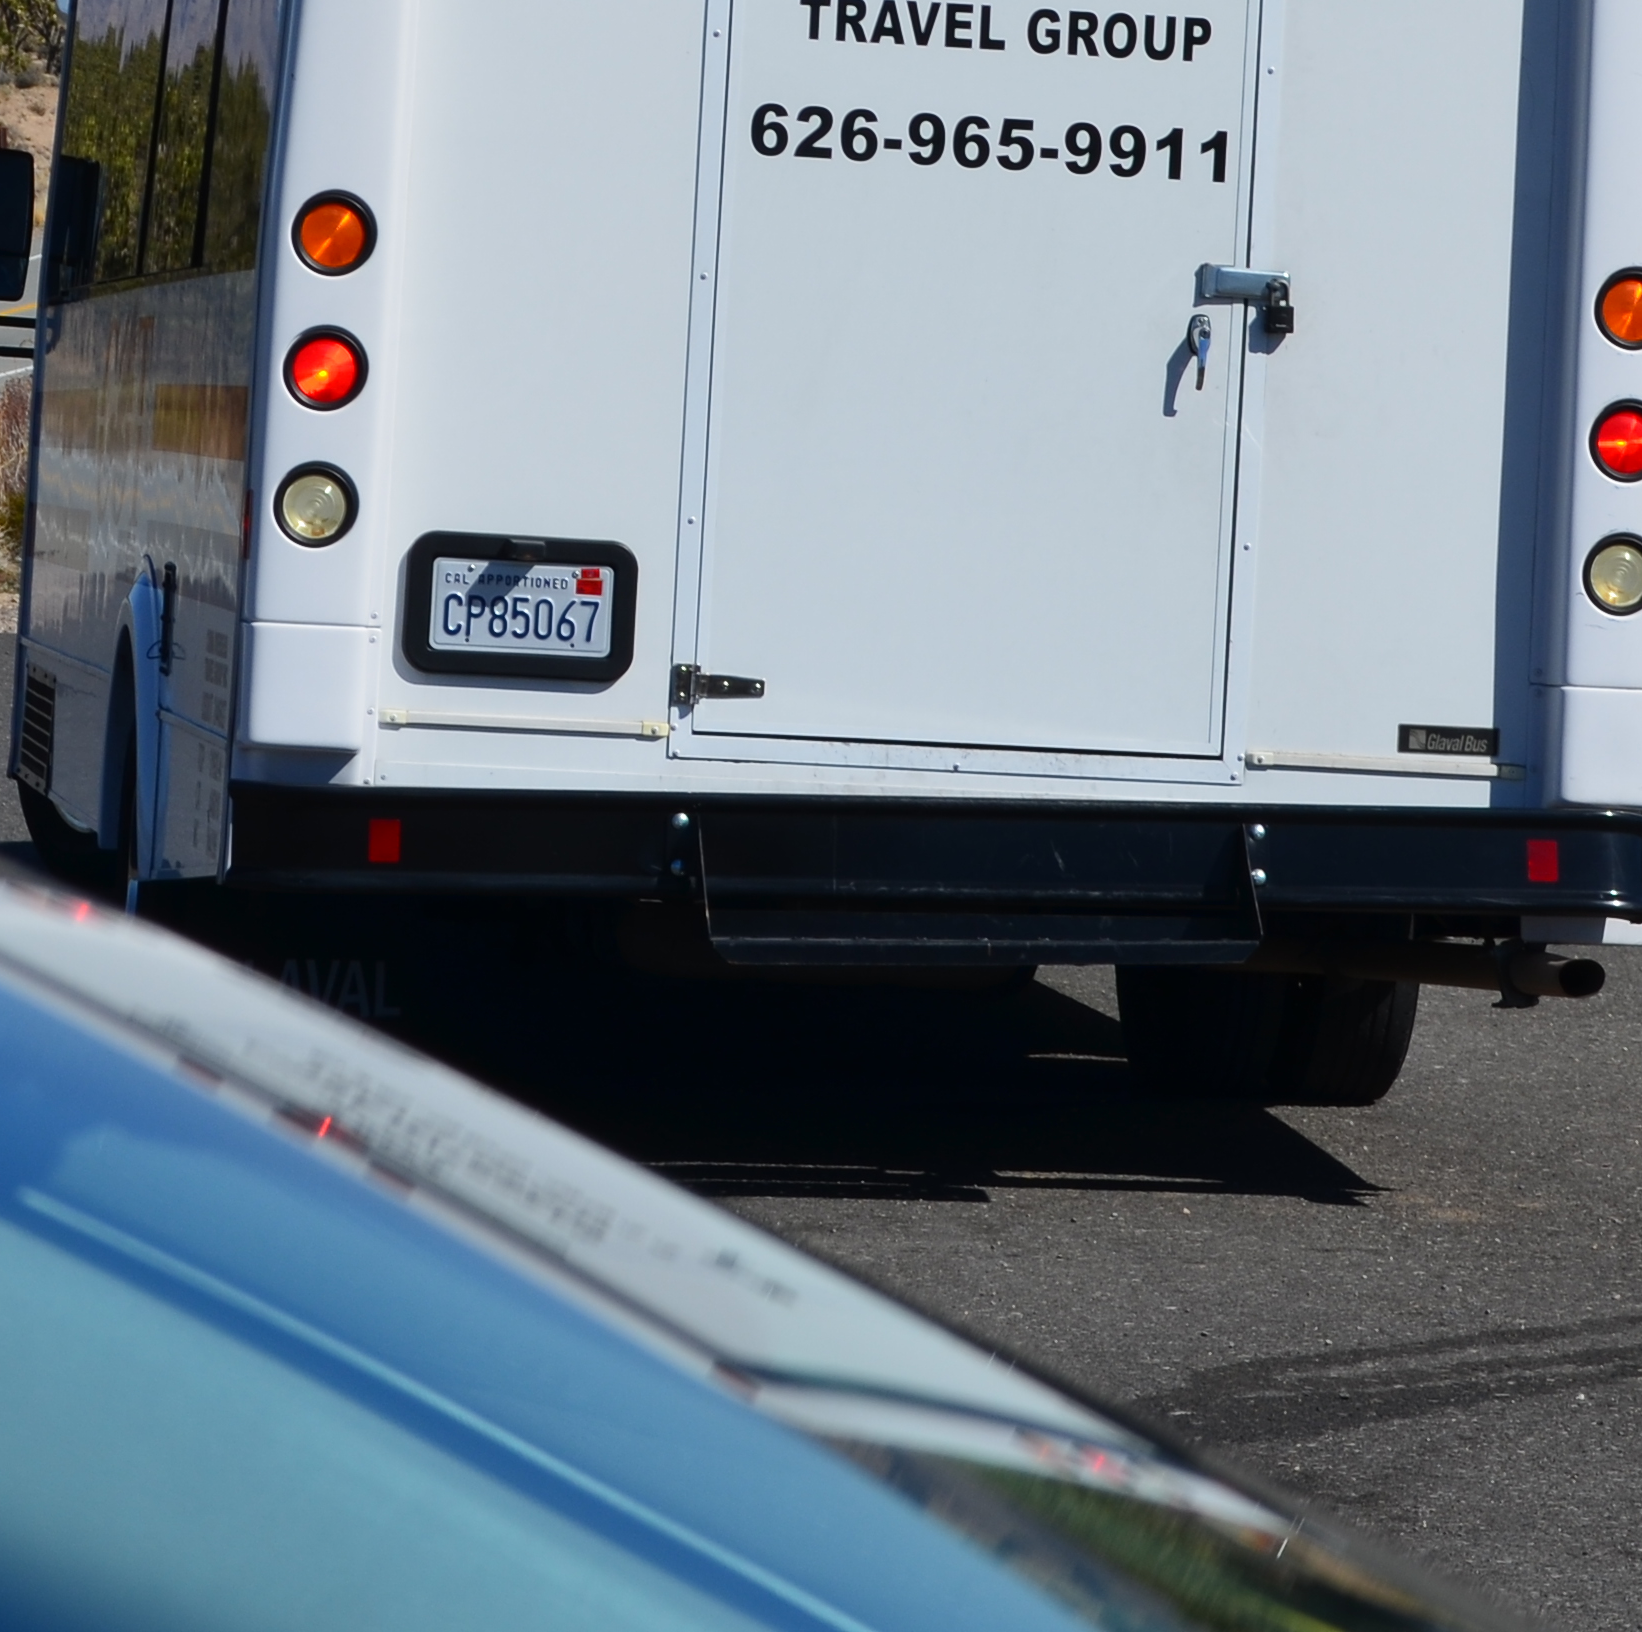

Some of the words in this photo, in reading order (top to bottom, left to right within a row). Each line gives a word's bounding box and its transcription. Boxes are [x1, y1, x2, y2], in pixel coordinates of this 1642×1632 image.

[1026, 8, 1213, 62] GROUP
[751, 103, 1229, 183] 626-965-9911
[444, 572, 470, 585] CAL
[478, 573, 569, 590] APPORTIONED
[443, 592, 600, 643] CP85067
[1427, 733, 1464, 751] Glaval
[1464, 735, 1488, 753] Bus
